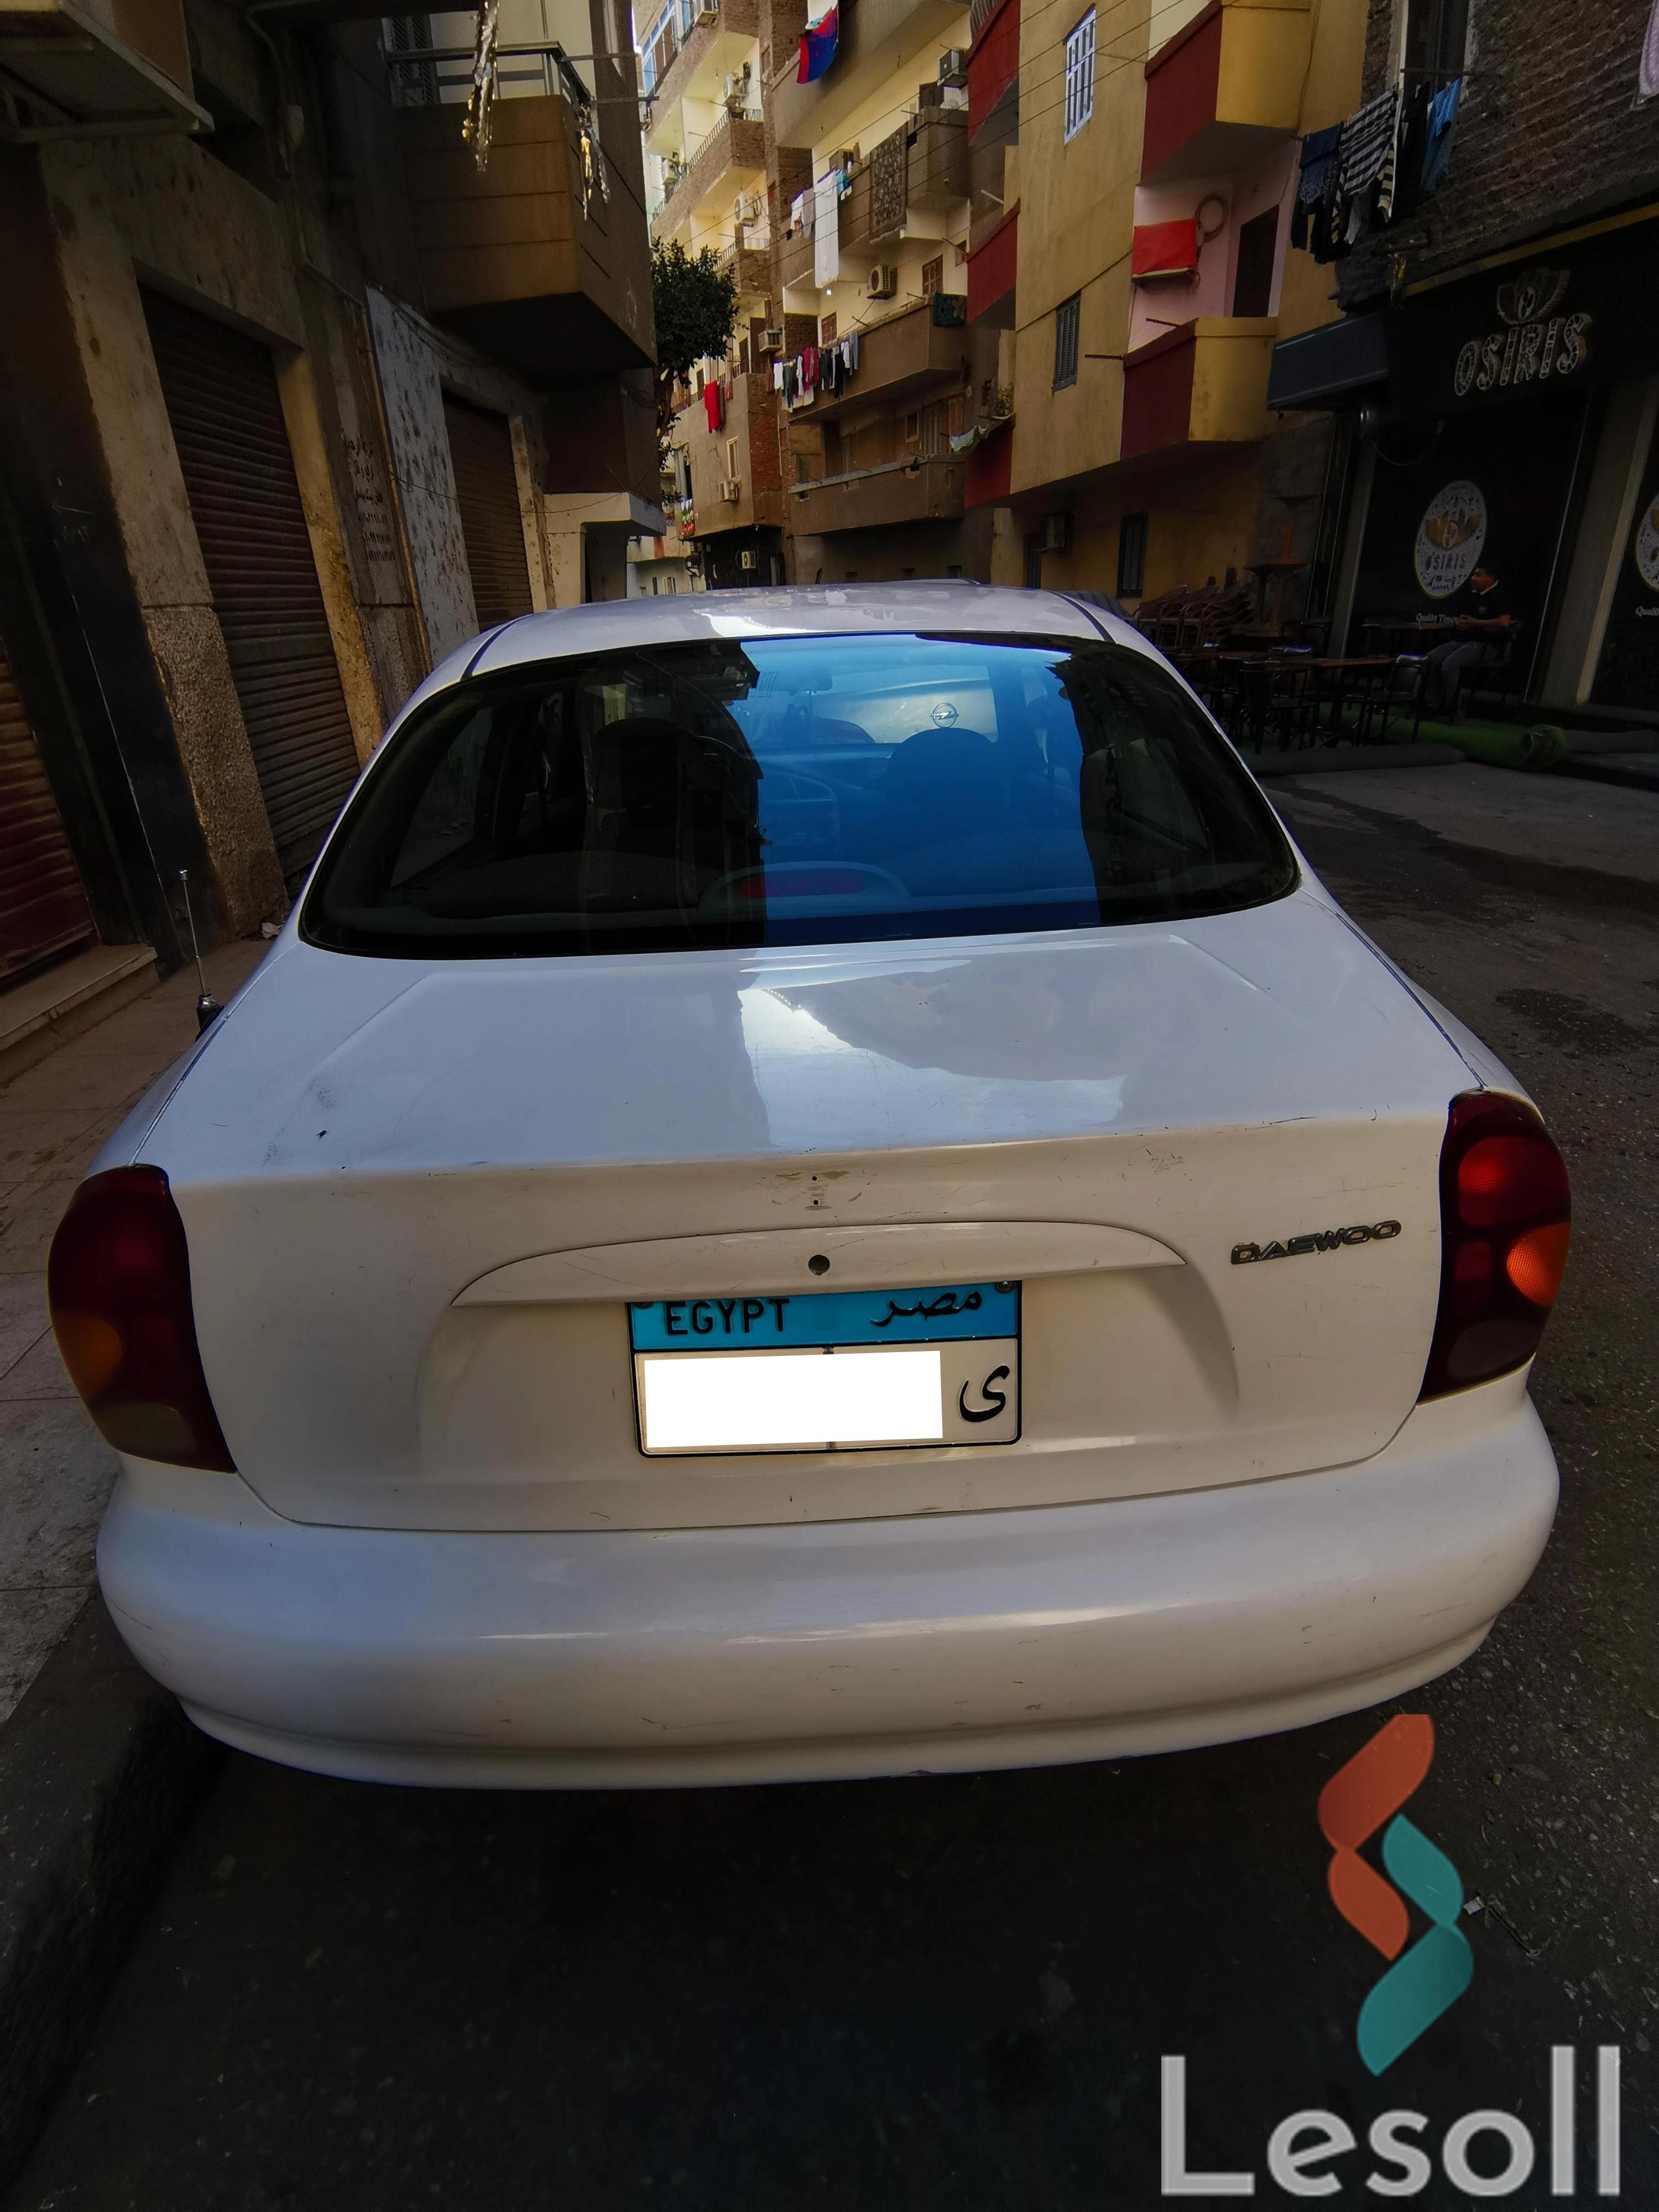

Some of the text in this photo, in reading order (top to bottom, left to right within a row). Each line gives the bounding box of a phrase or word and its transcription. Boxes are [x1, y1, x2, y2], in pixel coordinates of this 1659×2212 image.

[1454, 312, 1592, 397] OSIRIS
[1425, 552, 1467, 571] OSIRIS
[1230, 1220, 1402, 1265] DAEWOO
[665, 1297, 790, 1335] EGYPT
[869, 1289, 983, 1327] مصر
